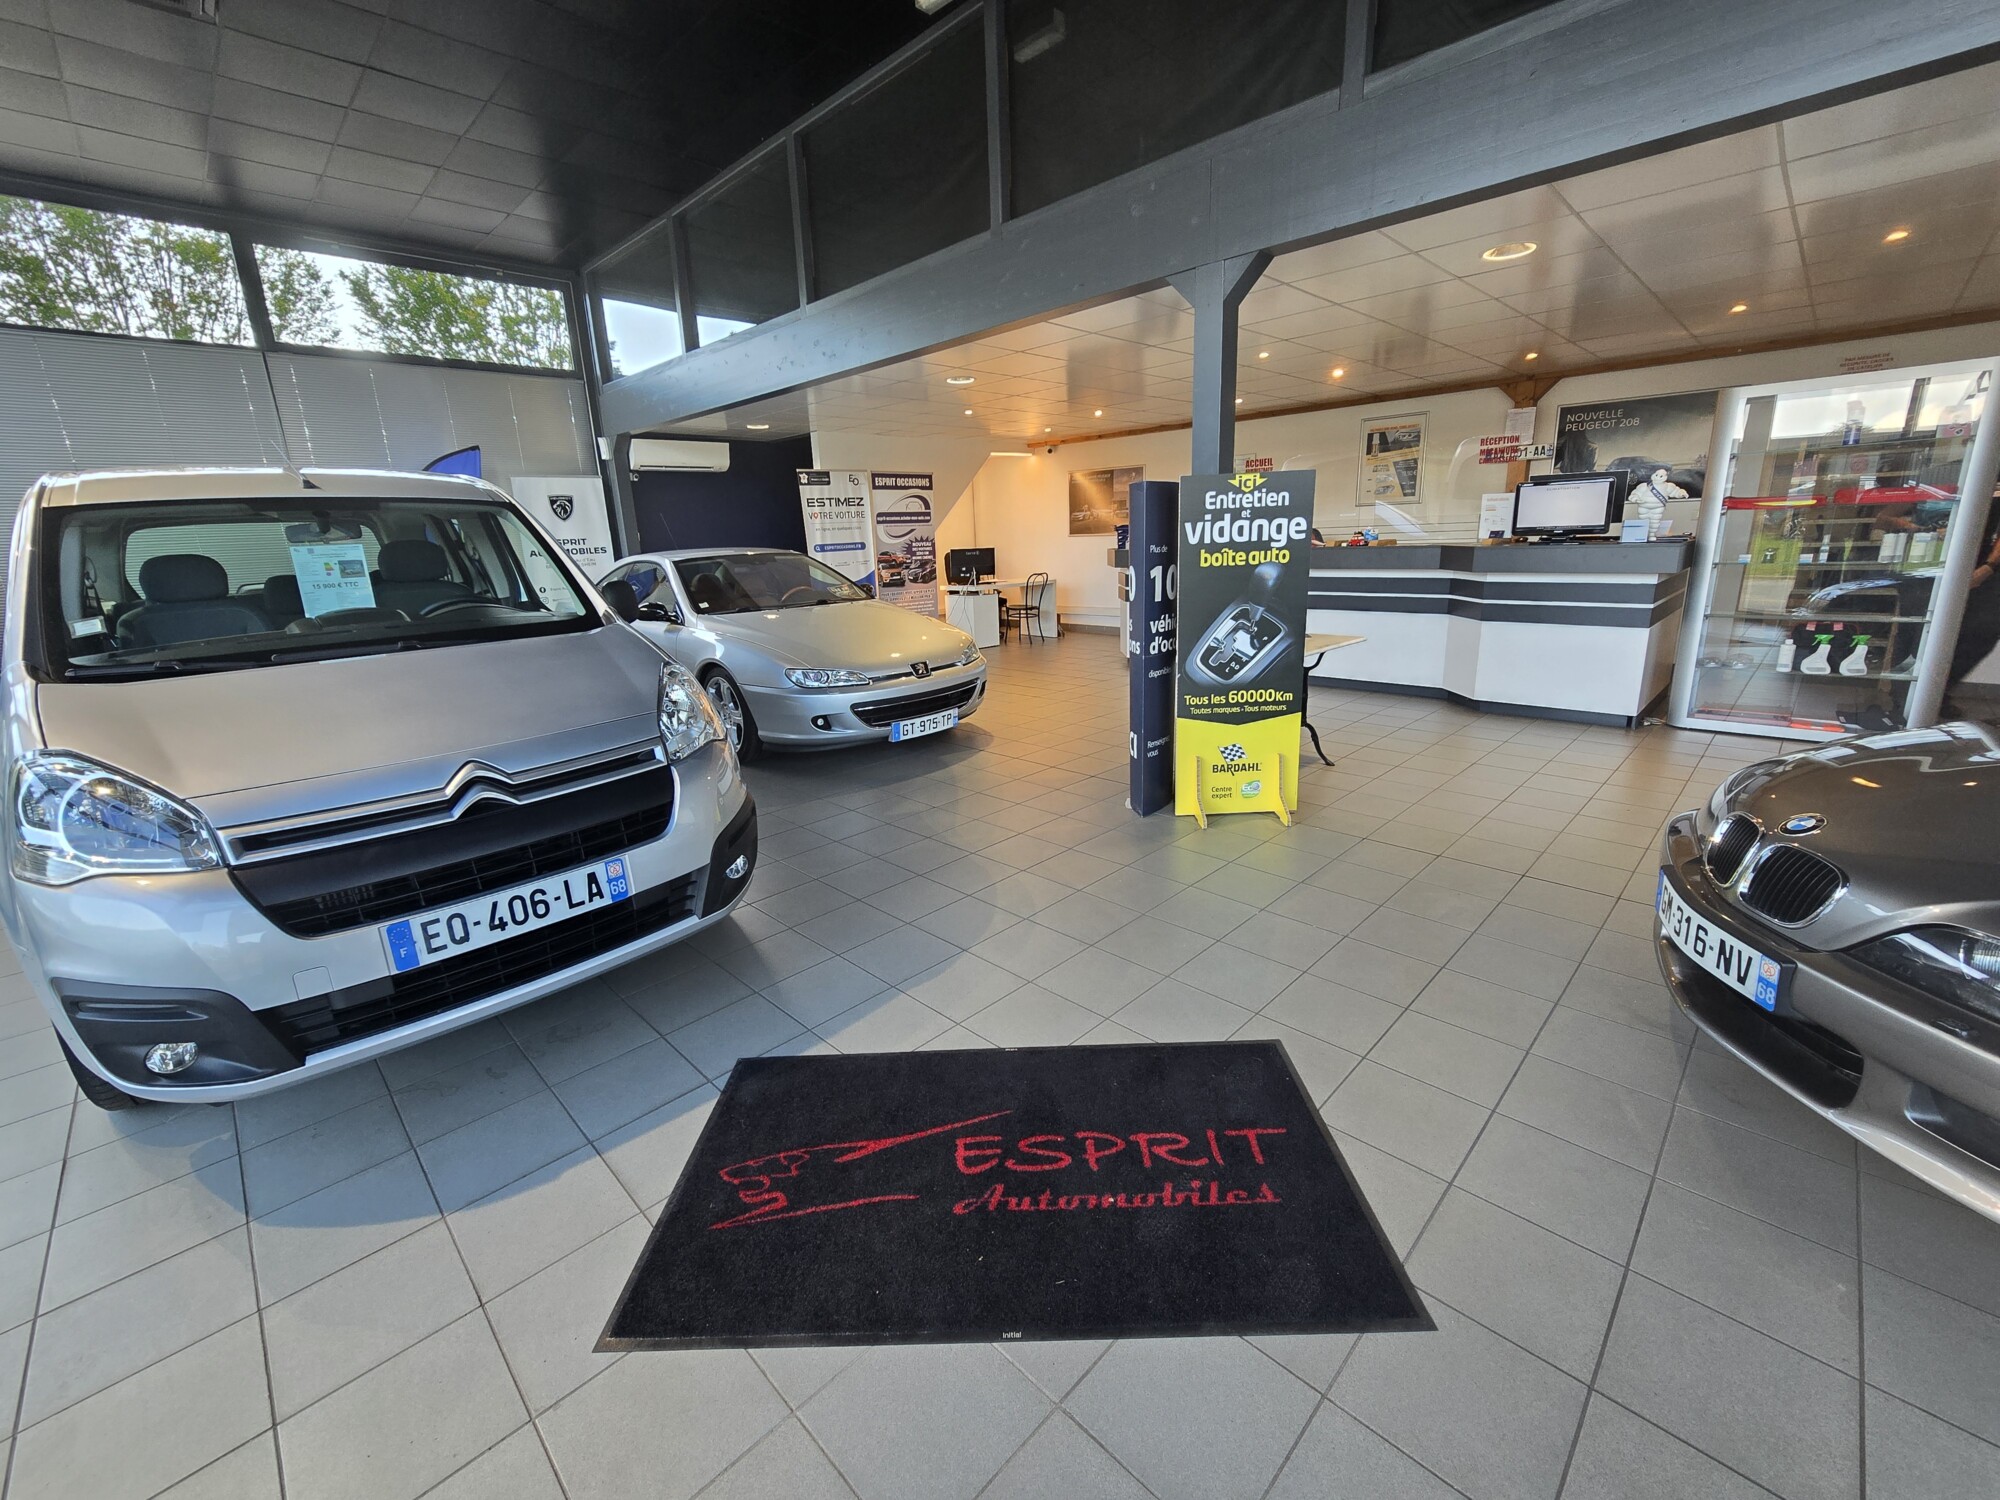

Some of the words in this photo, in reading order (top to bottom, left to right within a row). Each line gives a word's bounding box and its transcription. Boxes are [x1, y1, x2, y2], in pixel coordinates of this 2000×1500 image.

[1567, 409, 1624, 422] NOUVELLE
[1565, 419, 1617, 432] PEUGEOT
[1620, 417, 1640, 428] 208
[1480, 435, 1520, 446] RÉCEPTION
[1245, 457, 1273, 468] ACCUEIL
[875, 477, 896, 486] ESPRIT
[896, 477, 930, 487] OCCASIONS
[1238, 475, 1257, 489] ici
[806, 497, 864, 507] ESTIMEZ
[1205, 488, 1290, 510] Entretien
[808, 511, 833, 520] VOTRE
[834, 511, 866, 519] VOITURE
[1241, 509, 1251, 518] et
[1184, 513, 1308, 548] vidange
[557, 538, 587, 546] SPRIT
[1149, 545, 1161, 553] Plus
[1200, 548, 1246, 567] boîte
[1248, 548, 1290, 565] auto
[1184, 695, 1209, 705] Tous
[1211, 694, 1226, 705] les
[1213, 706, 1240, 714] marques
[1260, 704, 1287, 712] moteurs
[902, 713, 952, 736] GT-975-TP
[1147, 749, 1159, 758] vous
[1212, 763, 1262, 777] BARDAHL
[400, 947, 408, 959] F
[420, 871, 605, 955] EQ-406-LA
[610, 879, 627, 895] 68
[1661, 885, 1753, 986] GM-316-NV
[1757, 982, 1776, 1005] 68
[955, 1128, 1287, 1175] ESPRIT
[952, 1180, 1282, 1214] Automobiles
